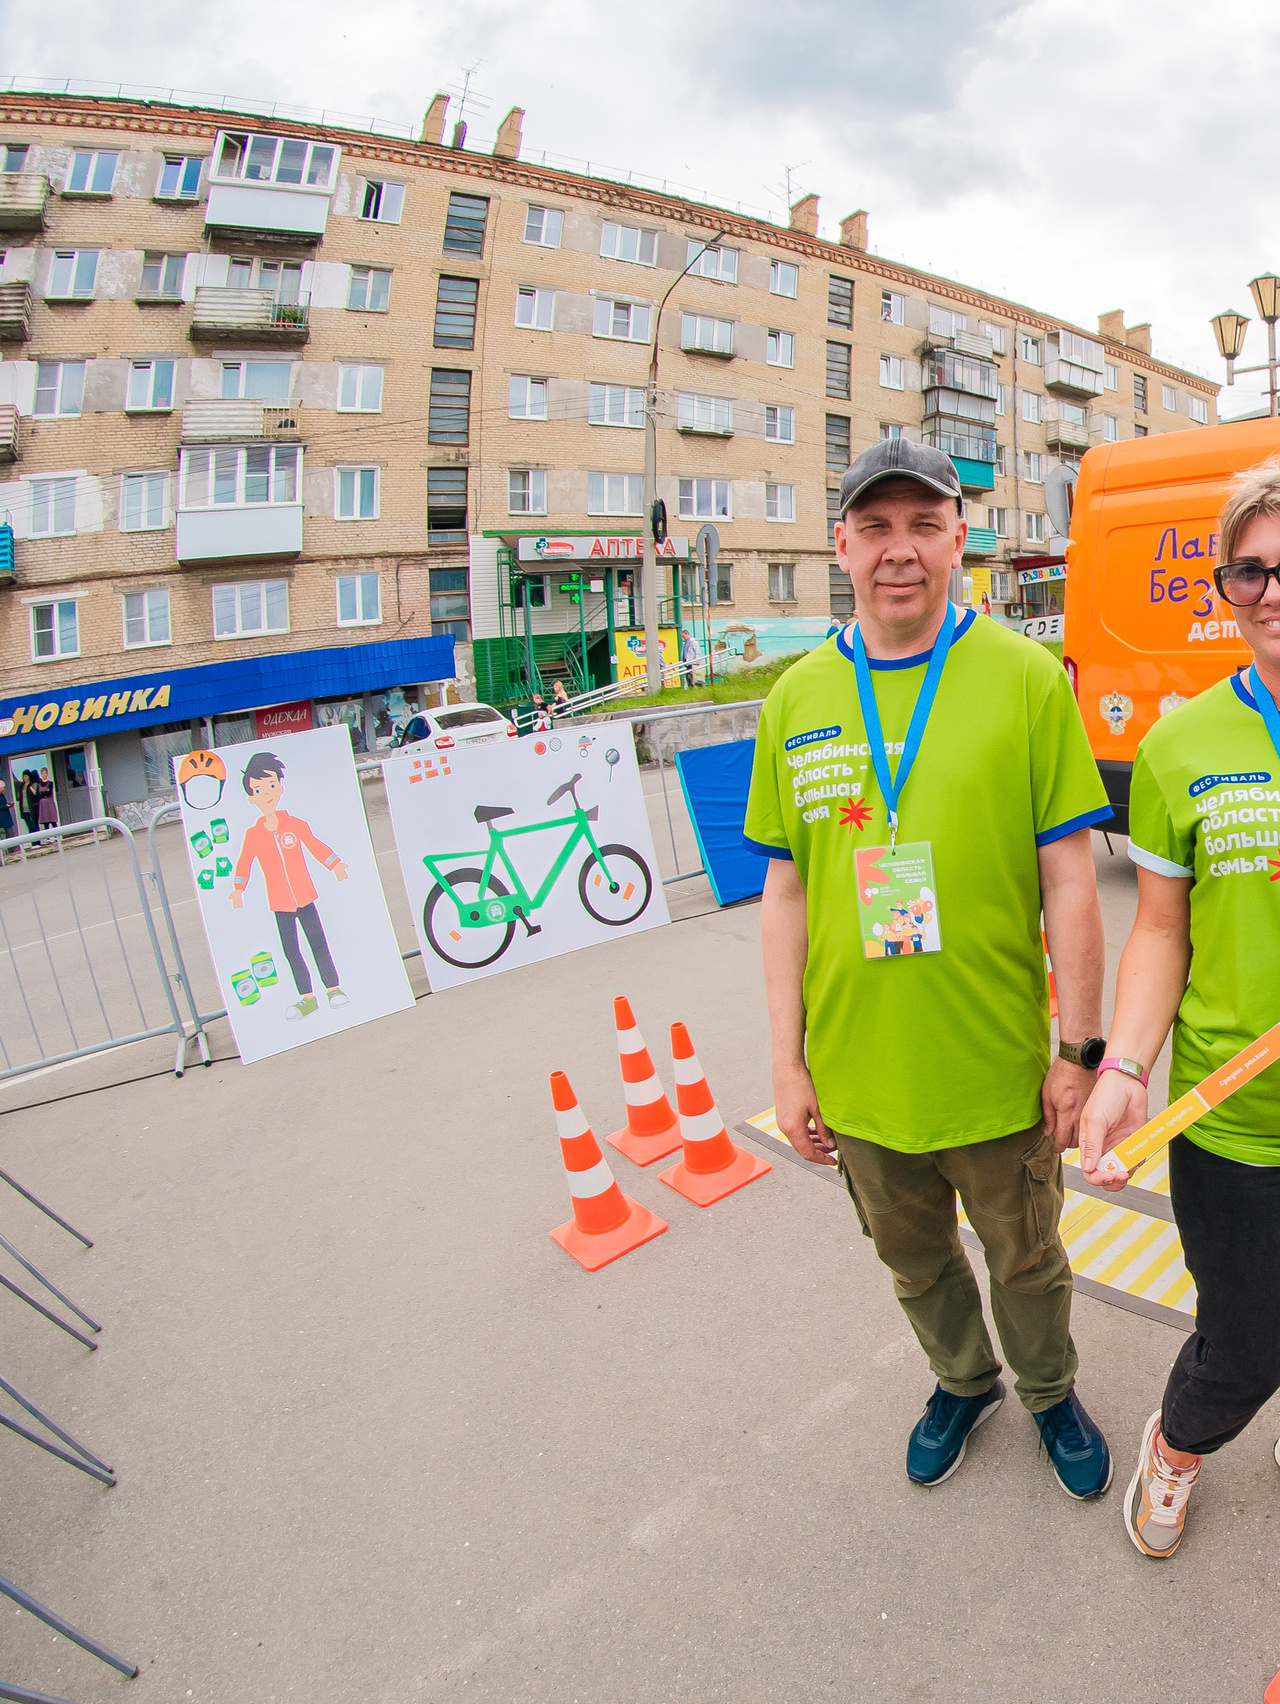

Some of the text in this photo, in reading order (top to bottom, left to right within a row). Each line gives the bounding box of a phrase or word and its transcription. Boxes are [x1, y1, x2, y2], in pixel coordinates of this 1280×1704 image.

[10, 684, 171, 735] НОВИНКА
[263, 708, 307, 726] ОДЕЖДА
[787, 729, 838, 747] ФЕСТИВАЛЬ
[787, 741, 906, 769] челябинсая
[1193, 774, 1266, 793] ФЕСТИВАЛЬ
[1210, 855, 1269, 877] семья
[1219, 1047, 1269, 1086] Средняя реакция
